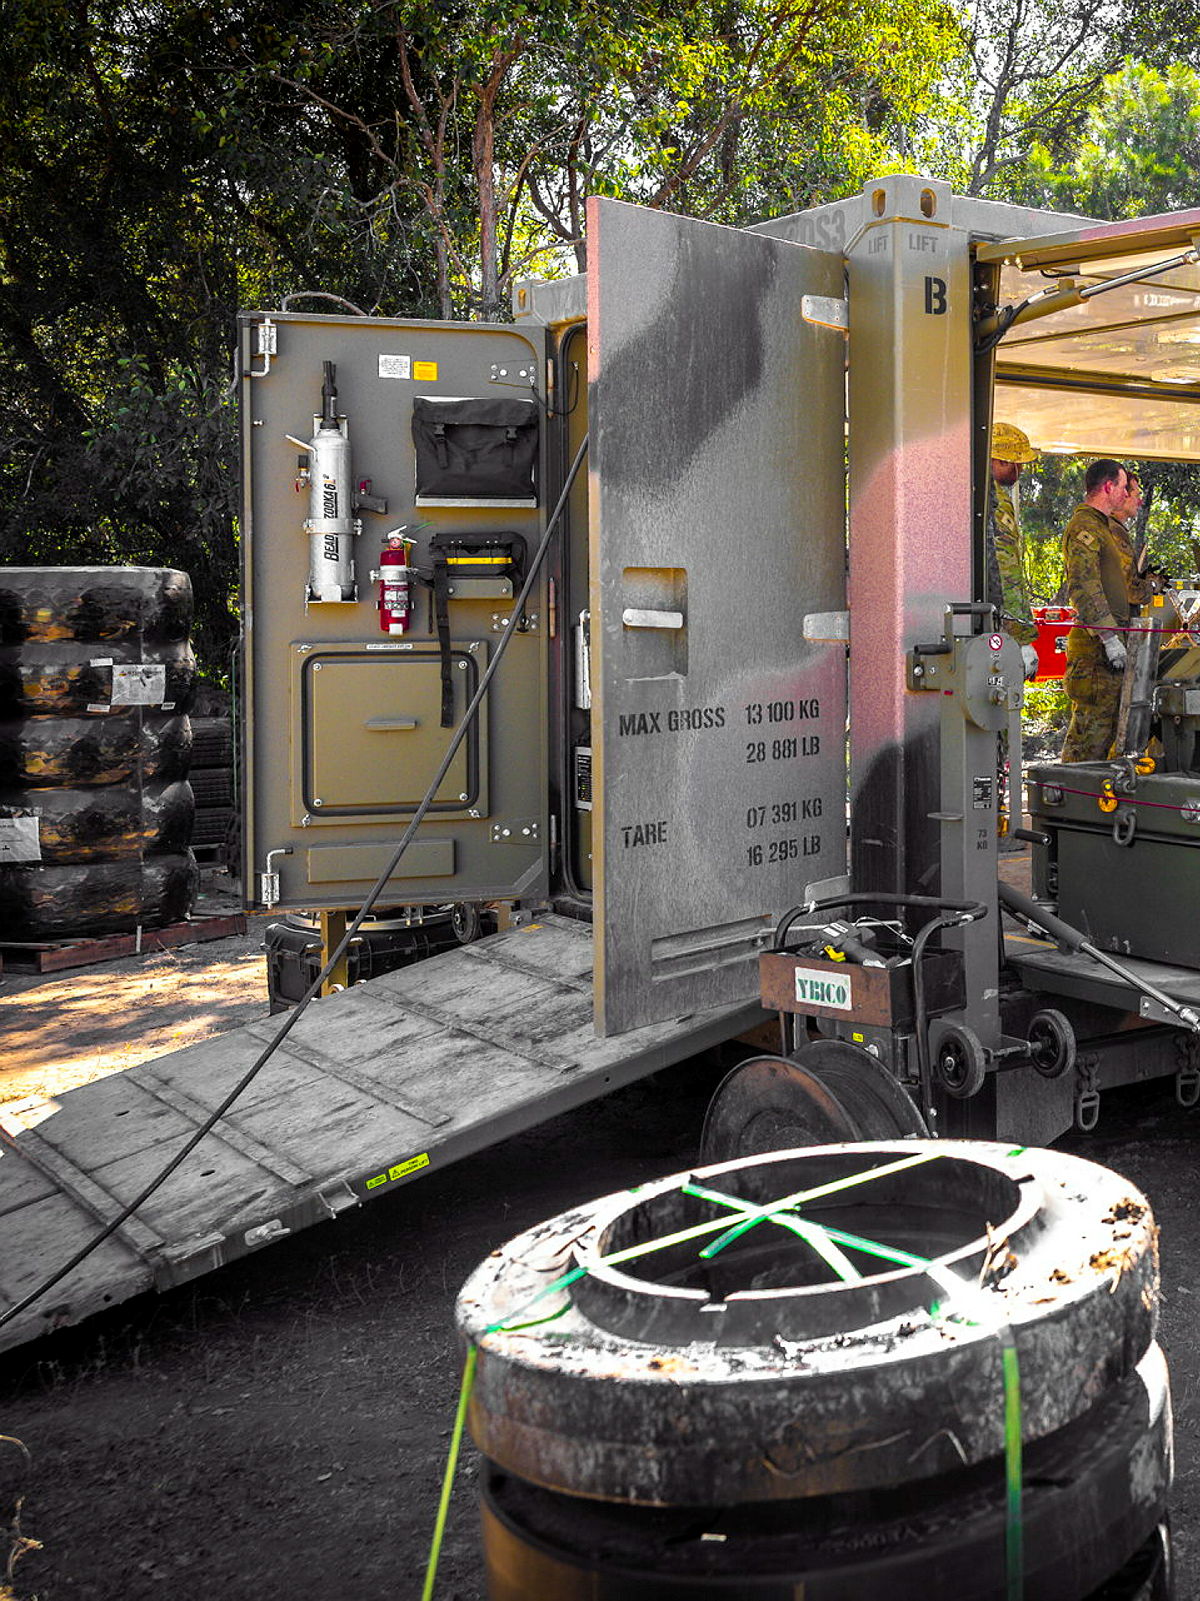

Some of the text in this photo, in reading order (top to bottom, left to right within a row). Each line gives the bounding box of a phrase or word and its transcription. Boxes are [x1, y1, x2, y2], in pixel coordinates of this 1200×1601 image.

[868, 235, 889, 255] LIFT
[909, 233, 939, 253] LIFT
[924, 275, 947, 315] B
[619, 698, 820, 737] MAX GROSS 13 100 KG
[746, 736, 820, 763] 28 881 LB
[620, 797, 823, 849] TARE 07 391 KG
[746, 835, 821, 867] 16 295 LB
[797, 978, 848, 1004] YBICO
